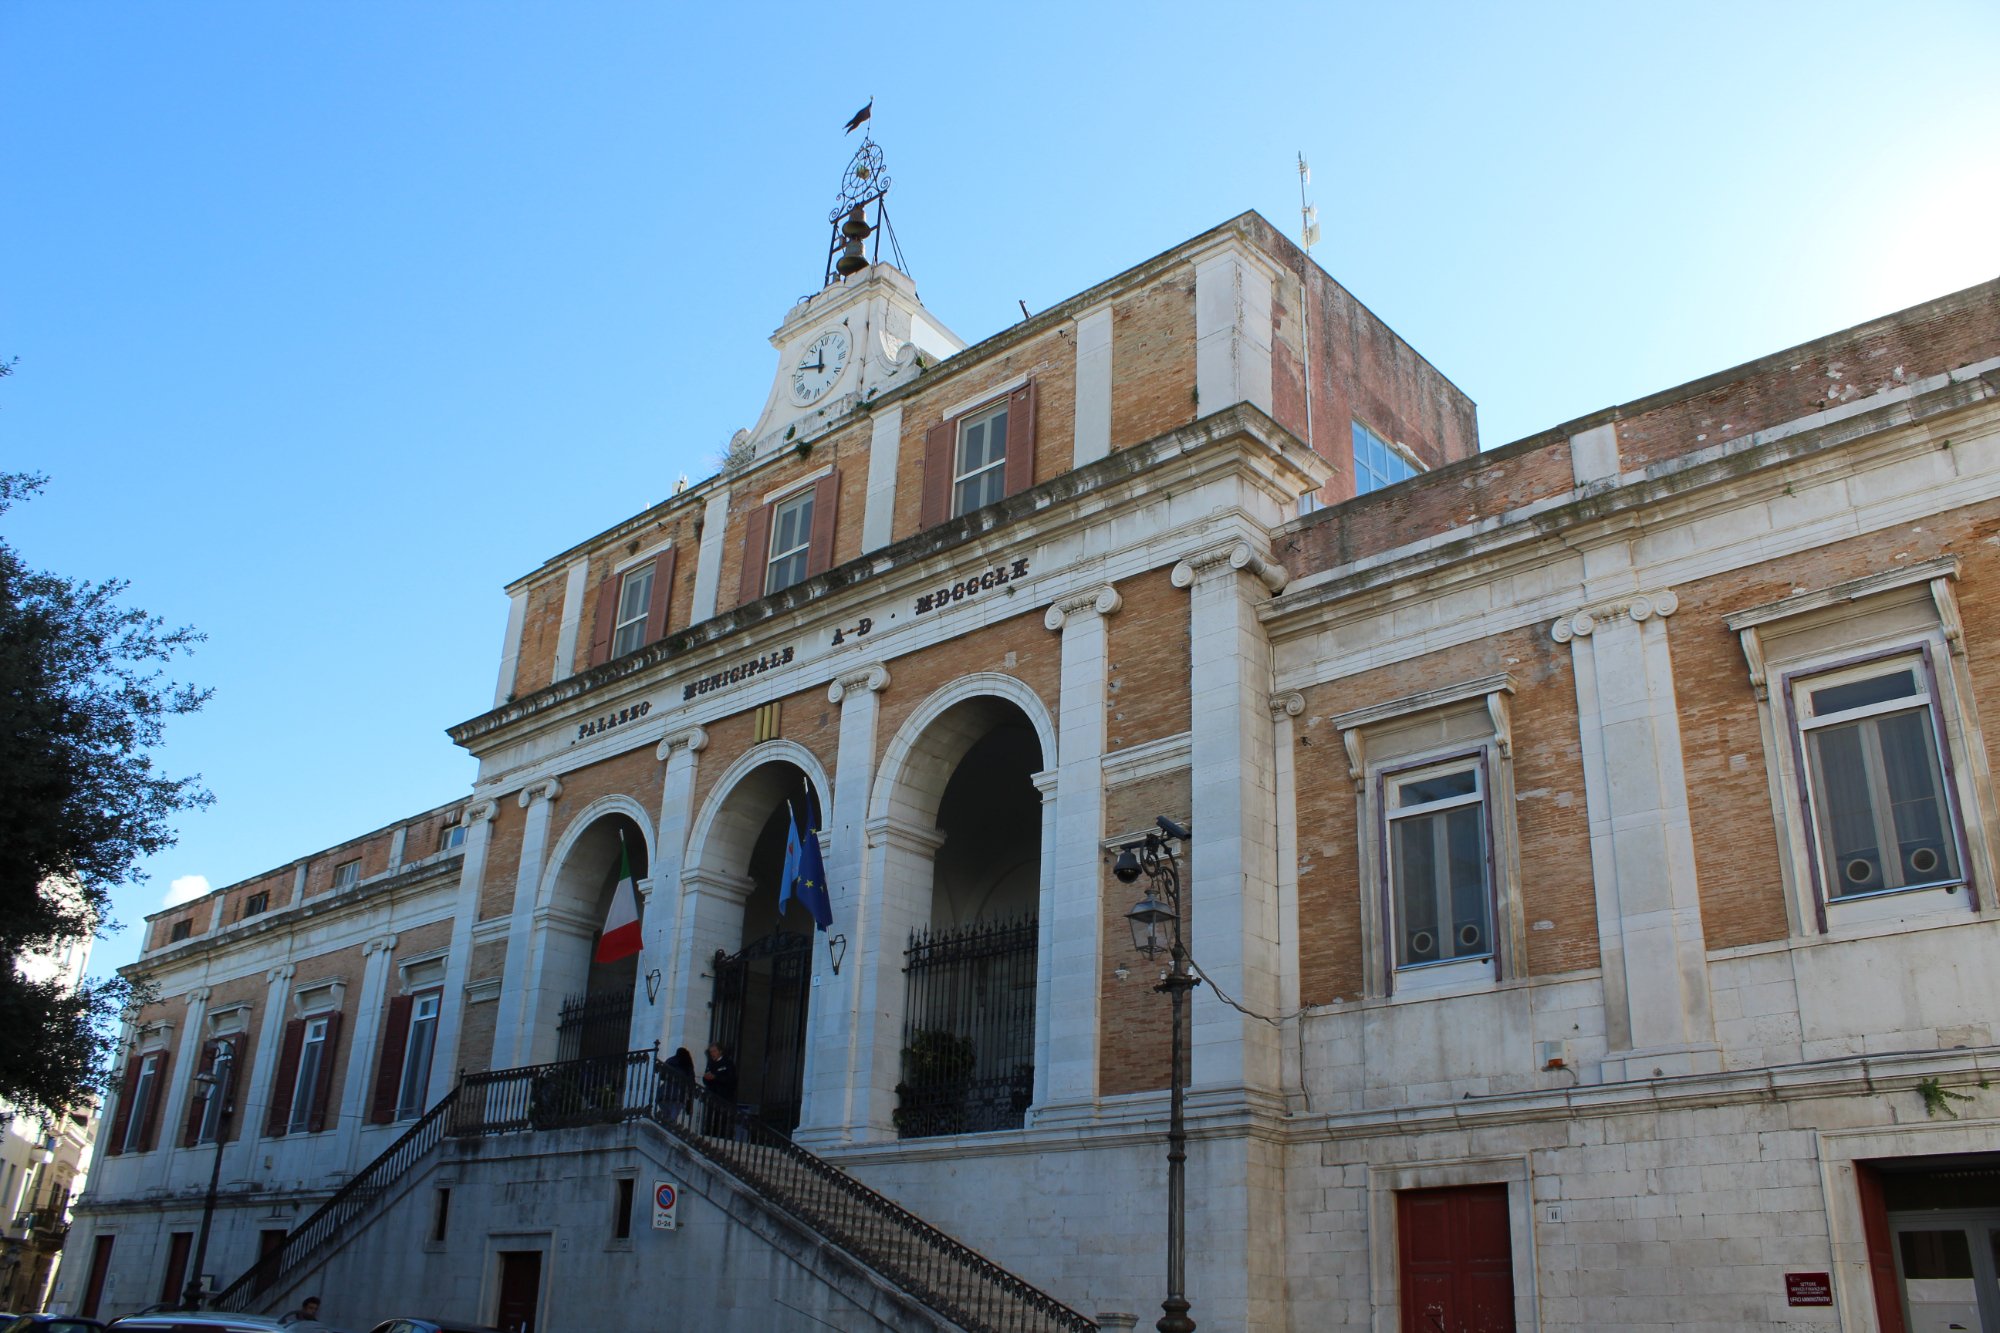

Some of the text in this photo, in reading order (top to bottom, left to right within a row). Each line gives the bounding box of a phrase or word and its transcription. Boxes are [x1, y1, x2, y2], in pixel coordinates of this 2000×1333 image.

[820, 336, 830, 347] XII
[810, 345, 817, 356] XI
[578, 701, 651, 740] PALAZZO
[683, 646, 795, 701] MUNICIPALE
